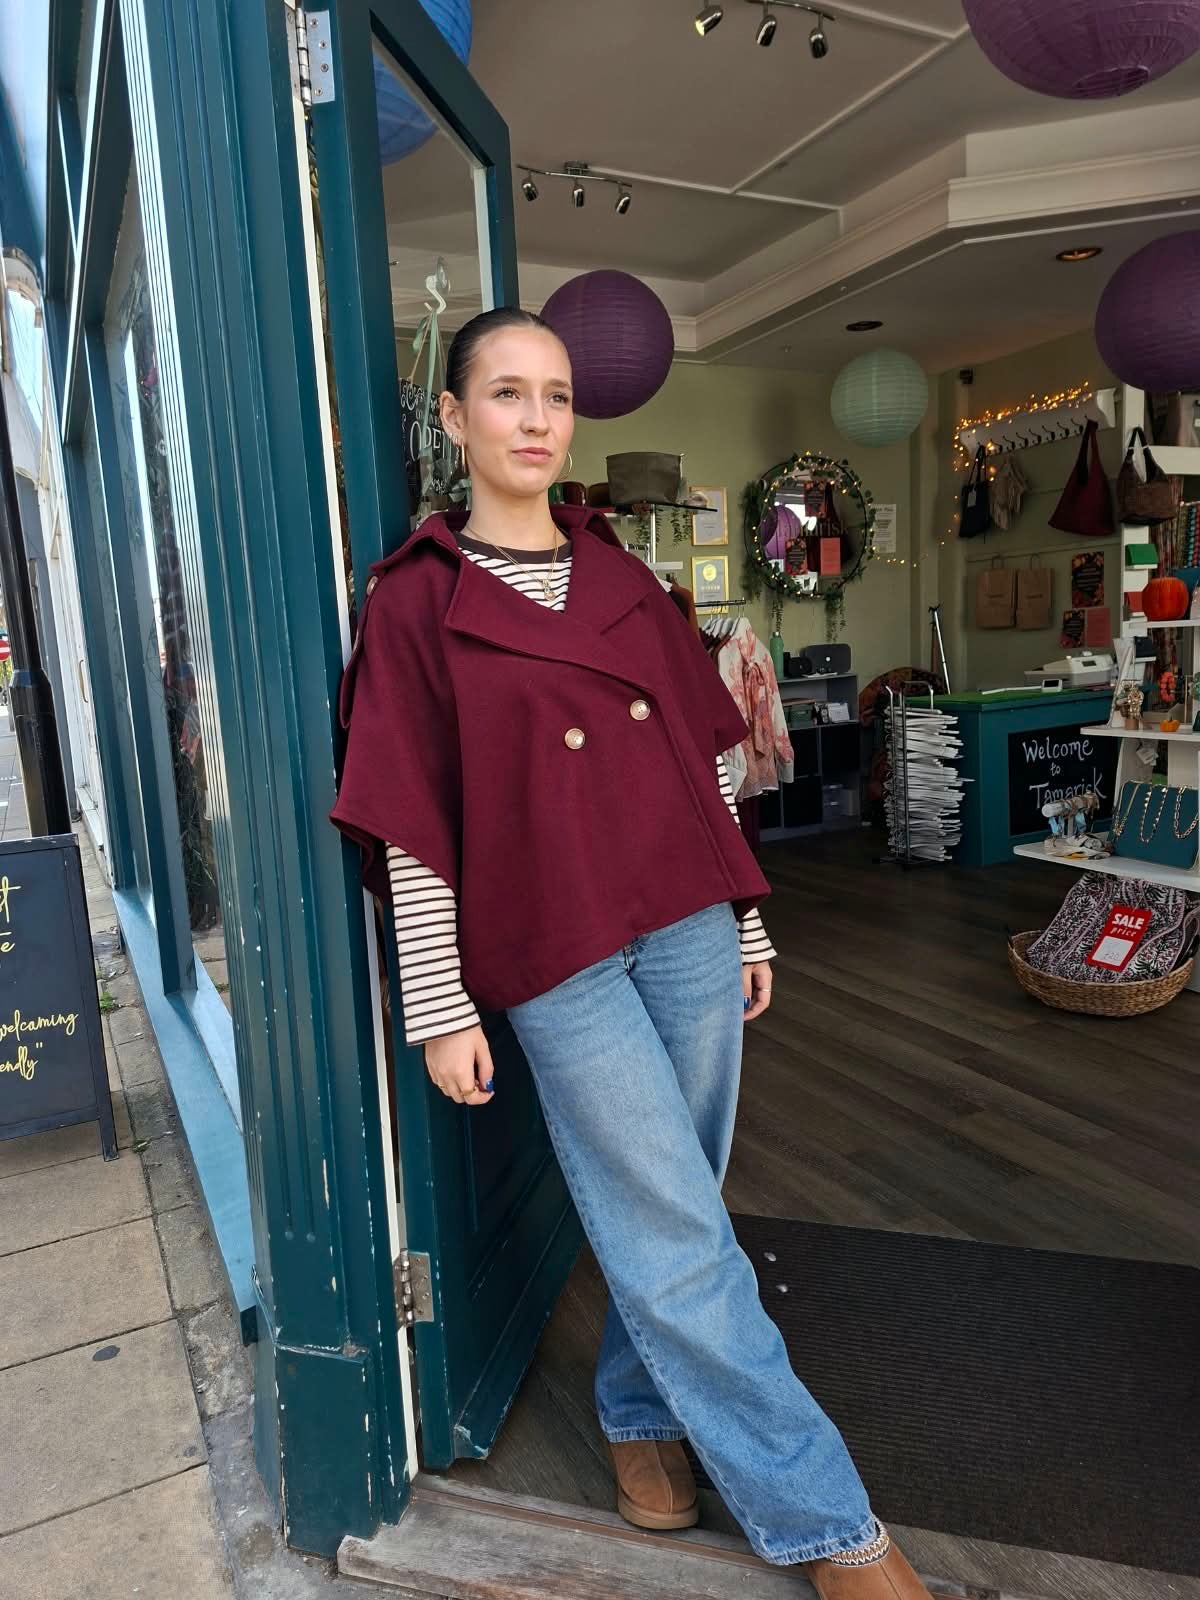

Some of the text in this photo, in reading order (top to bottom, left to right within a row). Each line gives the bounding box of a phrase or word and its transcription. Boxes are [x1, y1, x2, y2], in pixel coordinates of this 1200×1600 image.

[1022, 735, 1093, 763] Welcome
[1050, 761, 1061, 776] to
[1112, 913, 1144, 930] SALE
[1110, 927, 1136, 937] price
